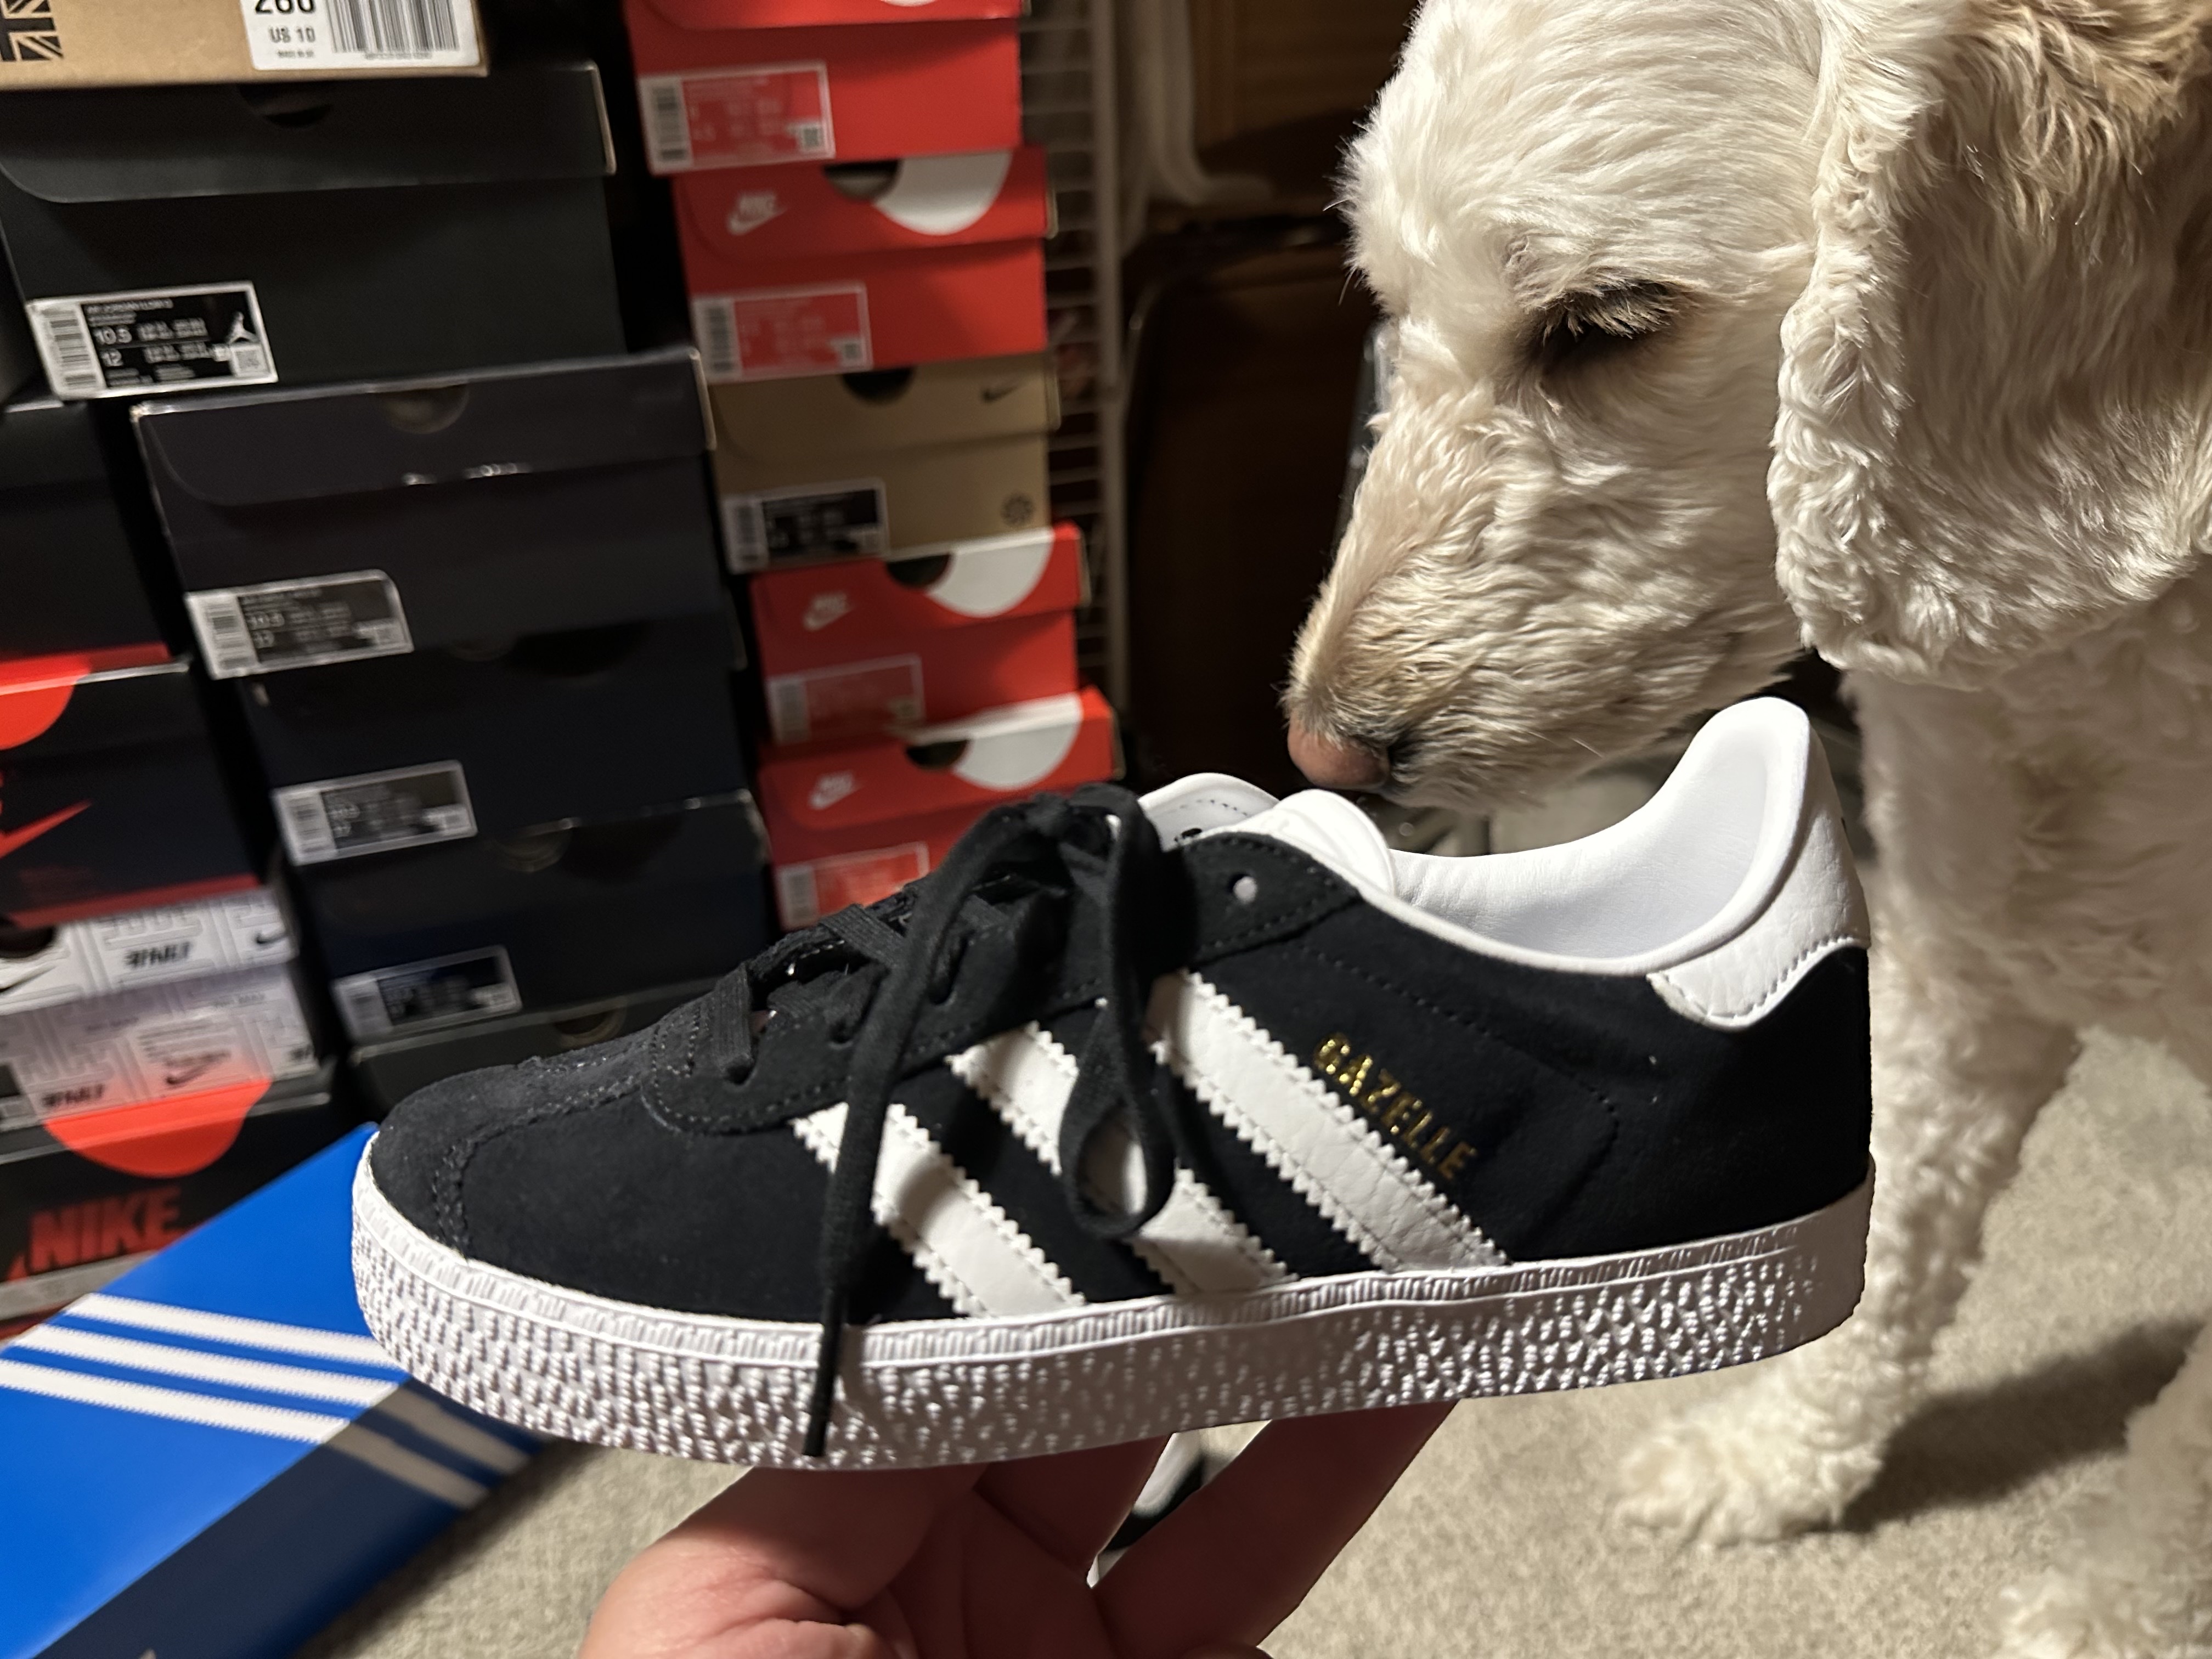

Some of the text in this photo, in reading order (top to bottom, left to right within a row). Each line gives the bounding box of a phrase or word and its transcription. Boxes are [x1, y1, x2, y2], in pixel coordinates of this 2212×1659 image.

[268, 26, 316, 43] US 10
[101, 348, 124, 366] 12
[1314, 1031, 1477, 1180] GAZELLE
[31, 1185, 188, 1271] NIKE
